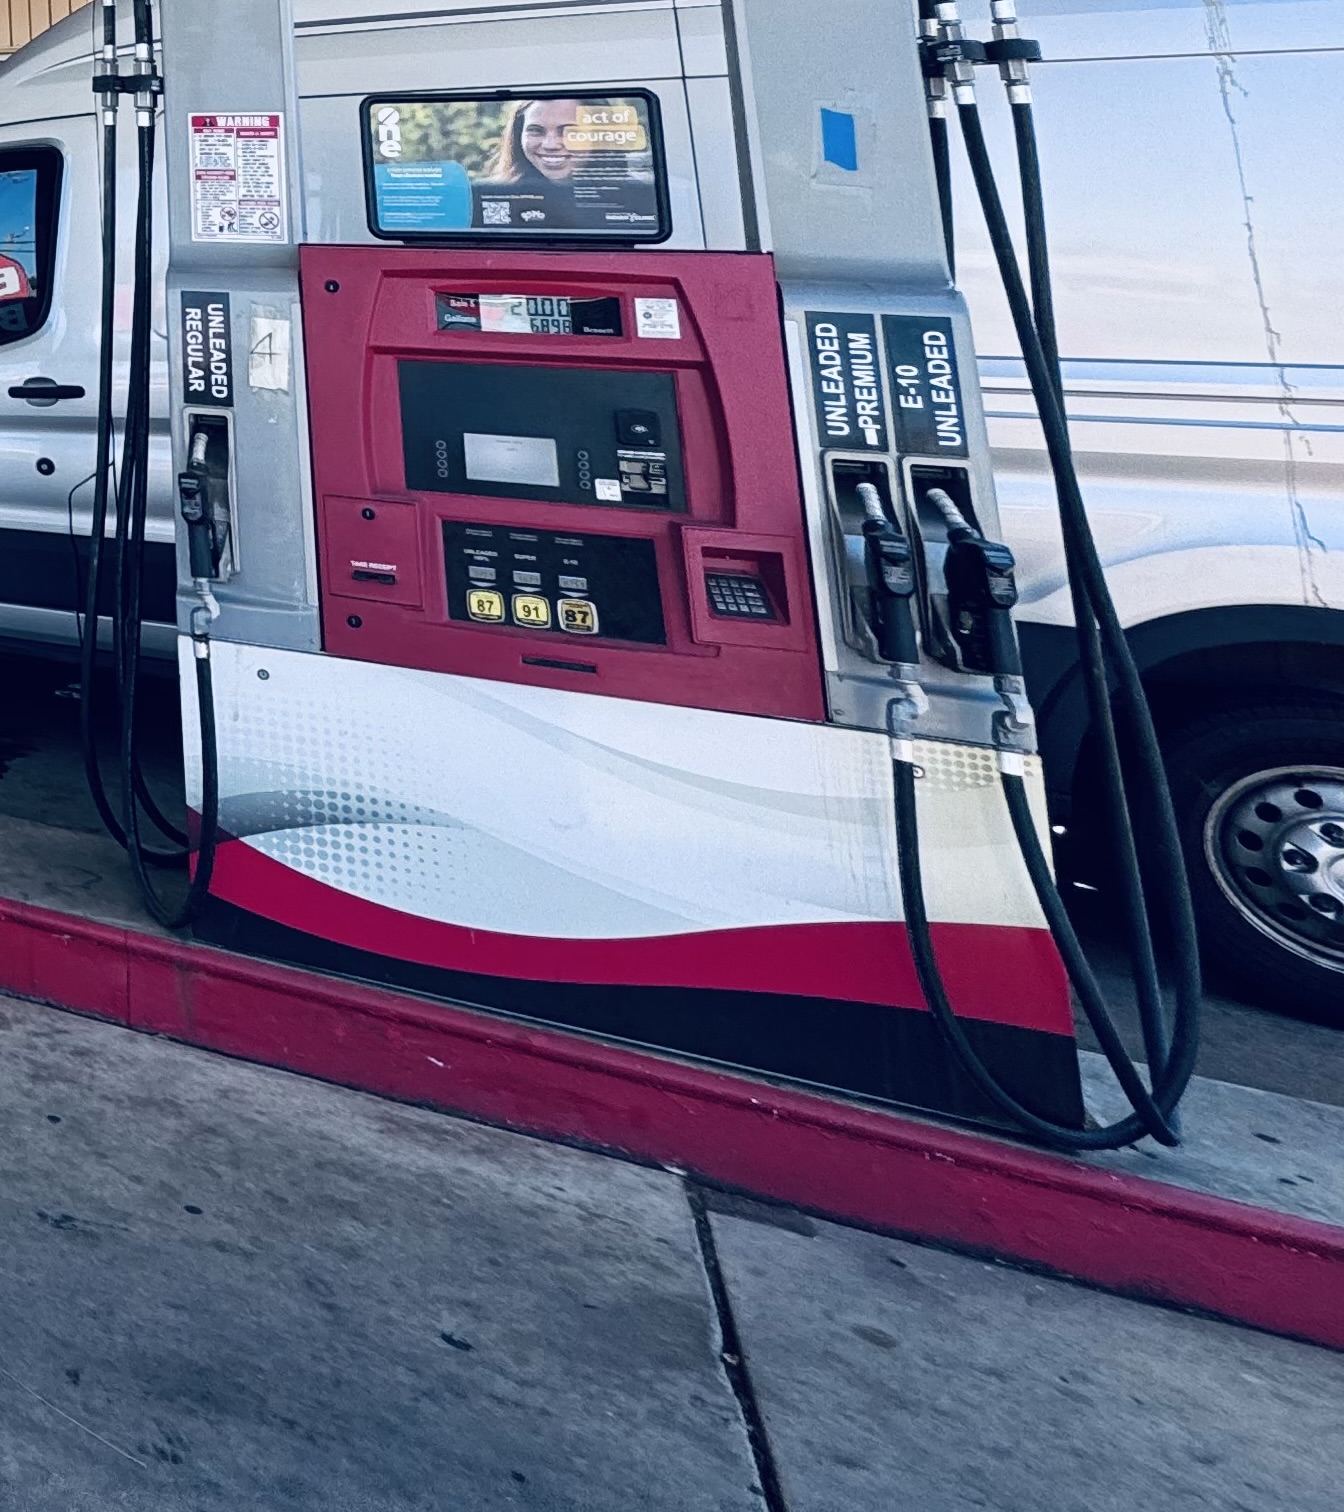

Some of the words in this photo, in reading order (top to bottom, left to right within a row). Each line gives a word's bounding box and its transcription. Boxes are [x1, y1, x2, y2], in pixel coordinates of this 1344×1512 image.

[216, 116, 270, 127] WARNING
[582, 111, 609, 124] act
[612, 110, 630, 123] of
[567, 131, 637, 145] courage
[185, 308, 205, 391] REGULAR
[207, 303, 229, 399] UNLEADED
[250, 332, 281, 364] 4
[815, 323, 851, 436] UNLEADED
[847, 333, 881, 430] PREMIUM
[895, 365, 925, 409] E-10
[923, 331, 962, 446] UNLEADED
[476, 599, 494, 613] 87
[522, 604, 540, 619] 91
[564, 609, 589, 624] 87
